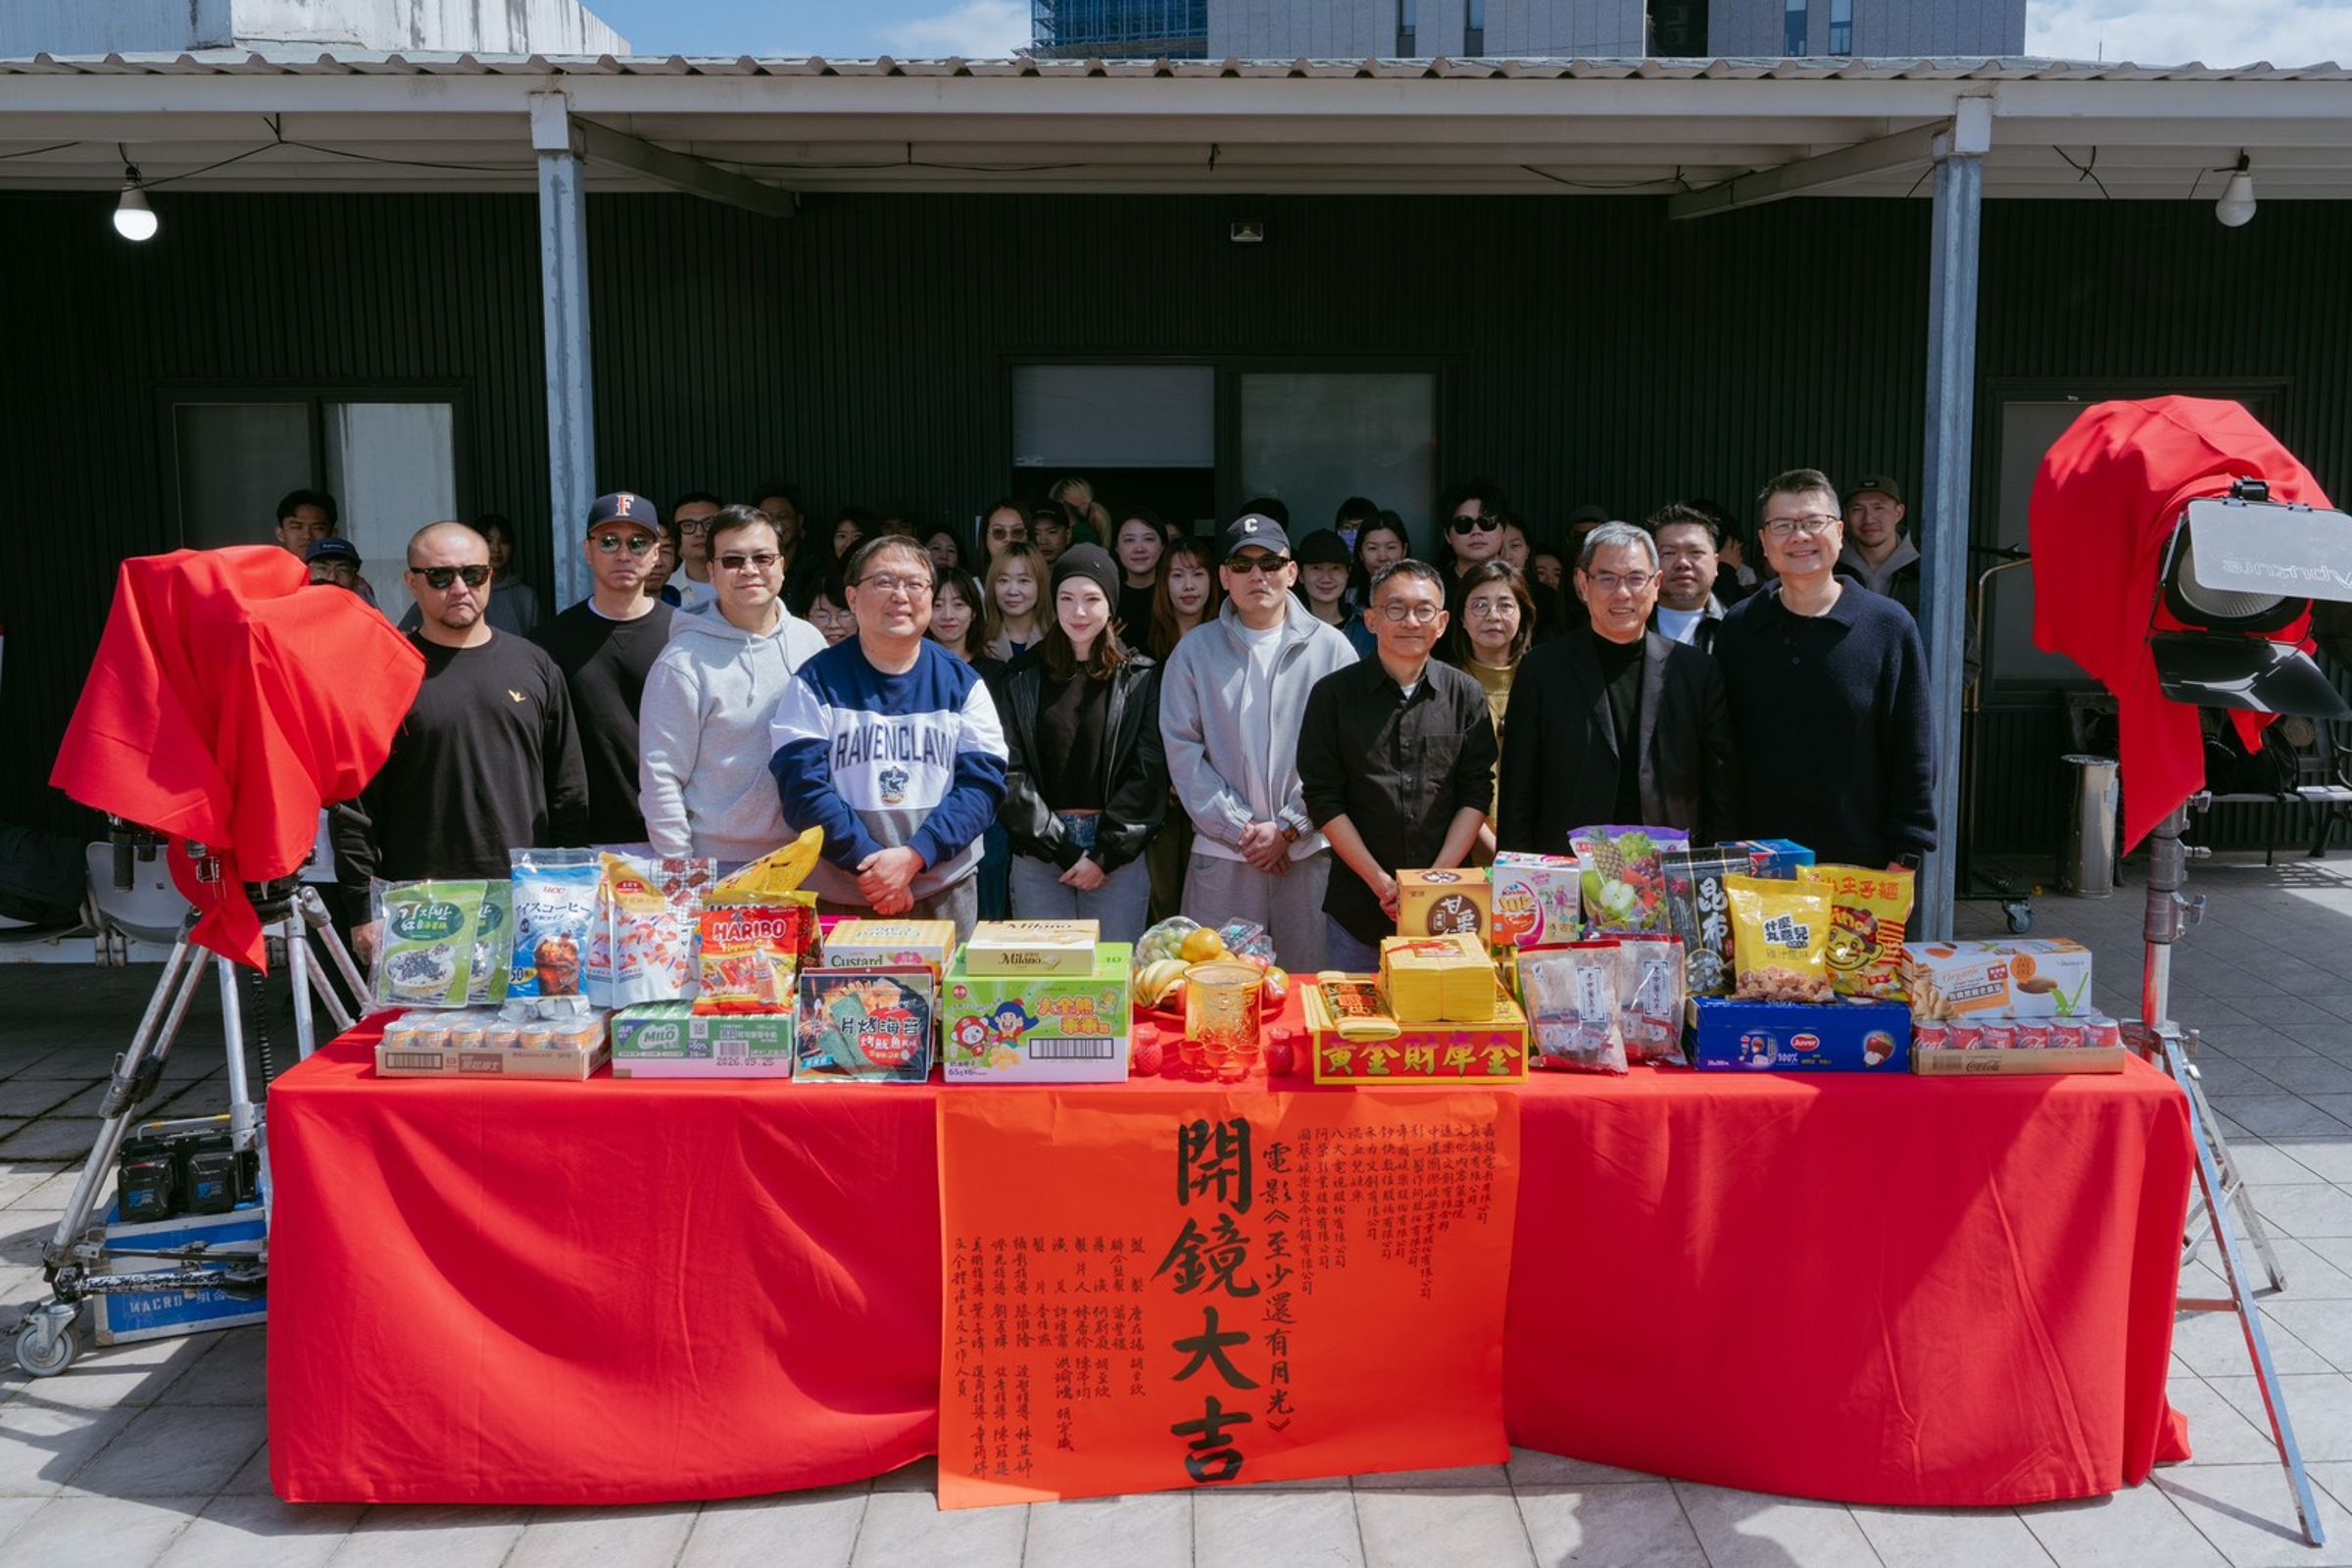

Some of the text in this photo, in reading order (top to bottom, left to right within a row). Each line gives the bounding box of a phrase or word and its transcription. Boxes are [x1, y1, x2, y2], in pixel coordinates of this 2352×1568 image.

[616, 493, 634, 516] F
[1244, 517, 1258, 533] C
[834, 722, 952, 771] RAVENCLAW
[712, 918, 787, 941] HARIBO
[830, 954, 883, 967] Custard
[643, 1029, 676, 1043] MILO
[1258, 1142, 1298, 1434] 電影《至少還有月光》
[1151, 1117, 1261, 1485] 開鏡大吉
